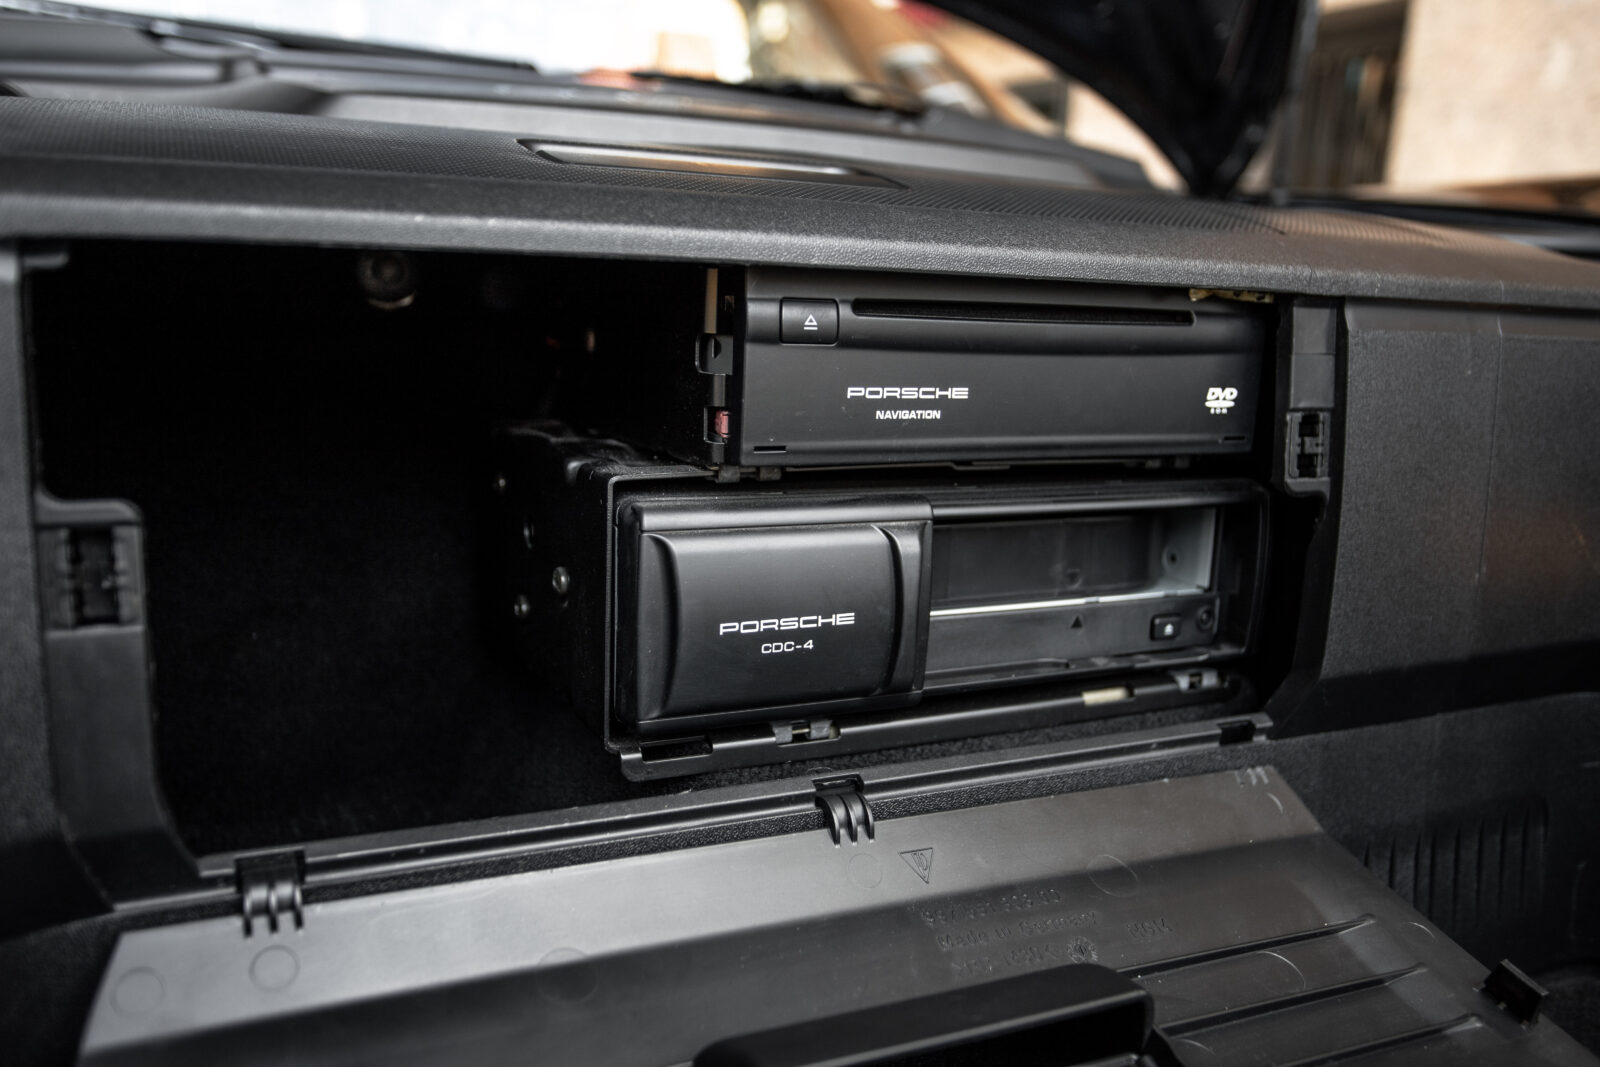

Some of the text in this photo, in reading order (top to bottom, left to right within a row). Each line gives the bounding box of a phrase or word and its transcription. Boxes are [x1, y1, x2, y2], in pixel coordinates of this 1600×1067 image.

[847, 387, 969, 399] PORSCHE
[1206, 387, 1239, 401] DVD
[875, 410, 941, 420] NAVIGATION
[719, 612, 855, 636] PORSCHE
[761, 639, 814, 654] CDC-4
[936, 928, 990, 952] Made
[995, 925, 1012, 939] in
